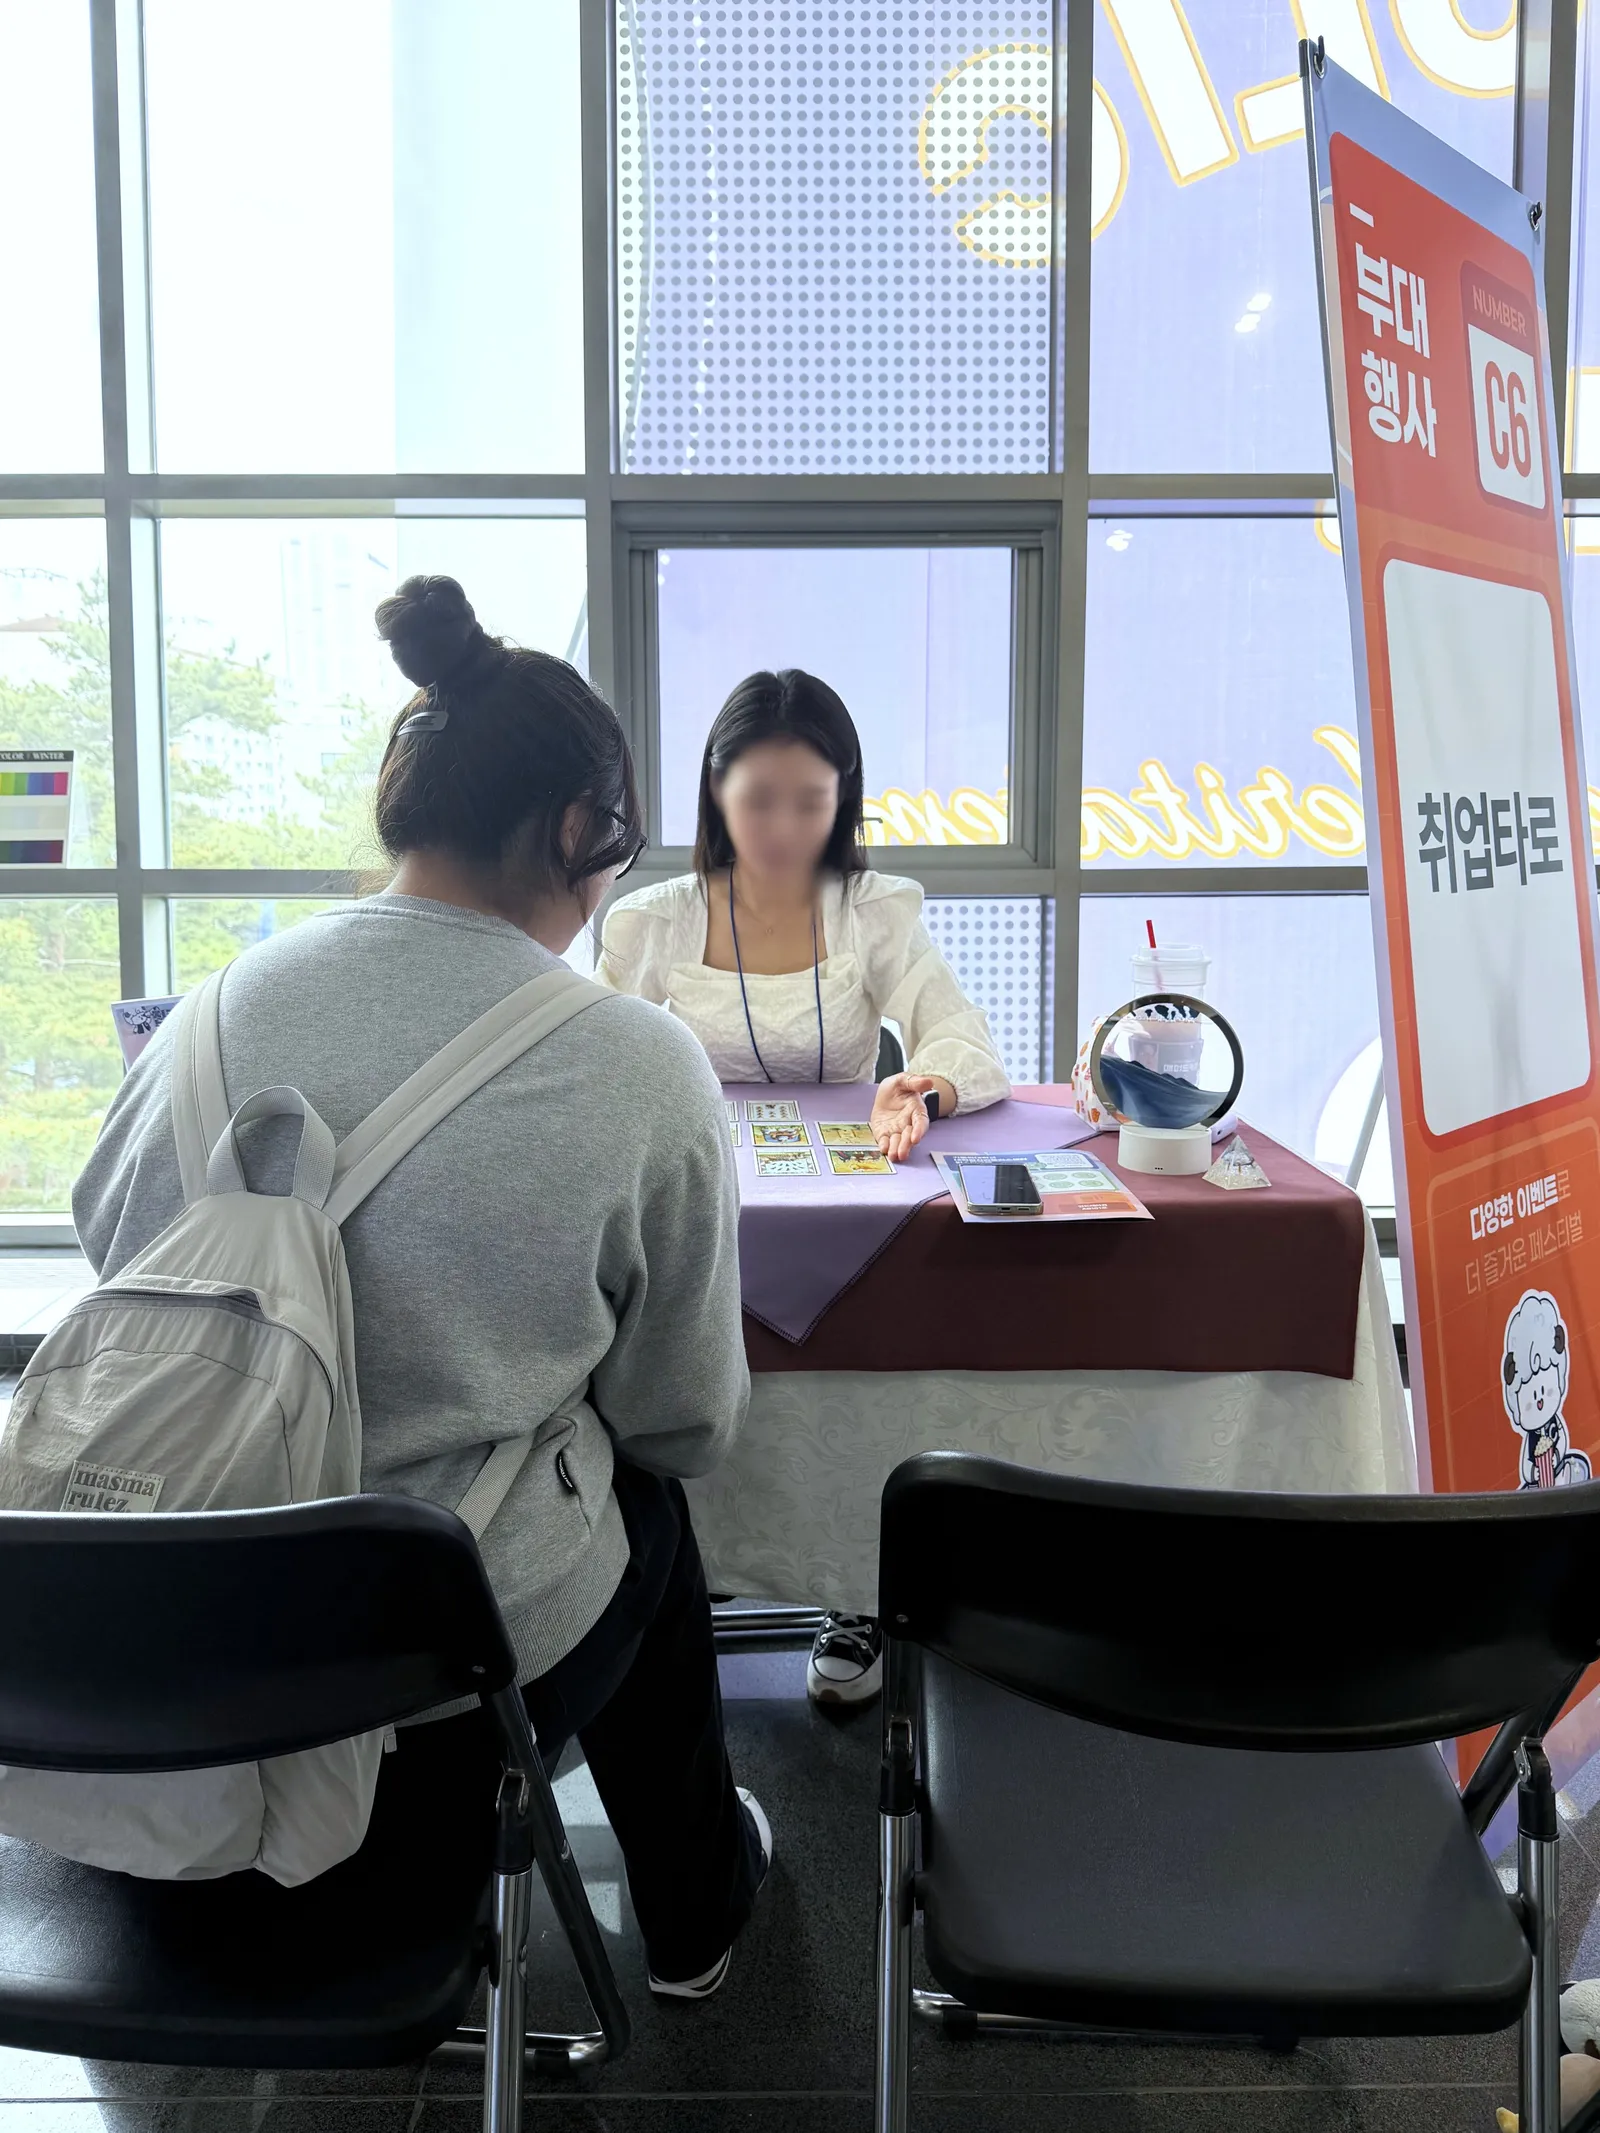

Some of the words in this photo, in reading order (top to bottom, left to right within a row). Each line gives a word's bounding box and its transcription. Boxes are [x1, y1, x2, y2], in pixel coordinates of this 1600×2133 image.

[1356, 242, 1430, 359] 부대
[1472, 285, 1528, 338] NUMBER
[1361, 349, 1438, 458] 행사
[1484, 361, 1533, 478] C6
[32, 751, 65, 761] WINTER
[1417, 791, 1564, 893] 취업타로
[1468, 1191, 1514, 1240] 다양한
[1516, 1169, 1572, 1218] 이벤트로
[1465, 1258, 1482, 1294] 더
[1484, 1238, 1527, 1286] 즐거운
[1529, 1209, 1584, 1262] 페스티벌
[74, 1470, 156, 1496] masma
